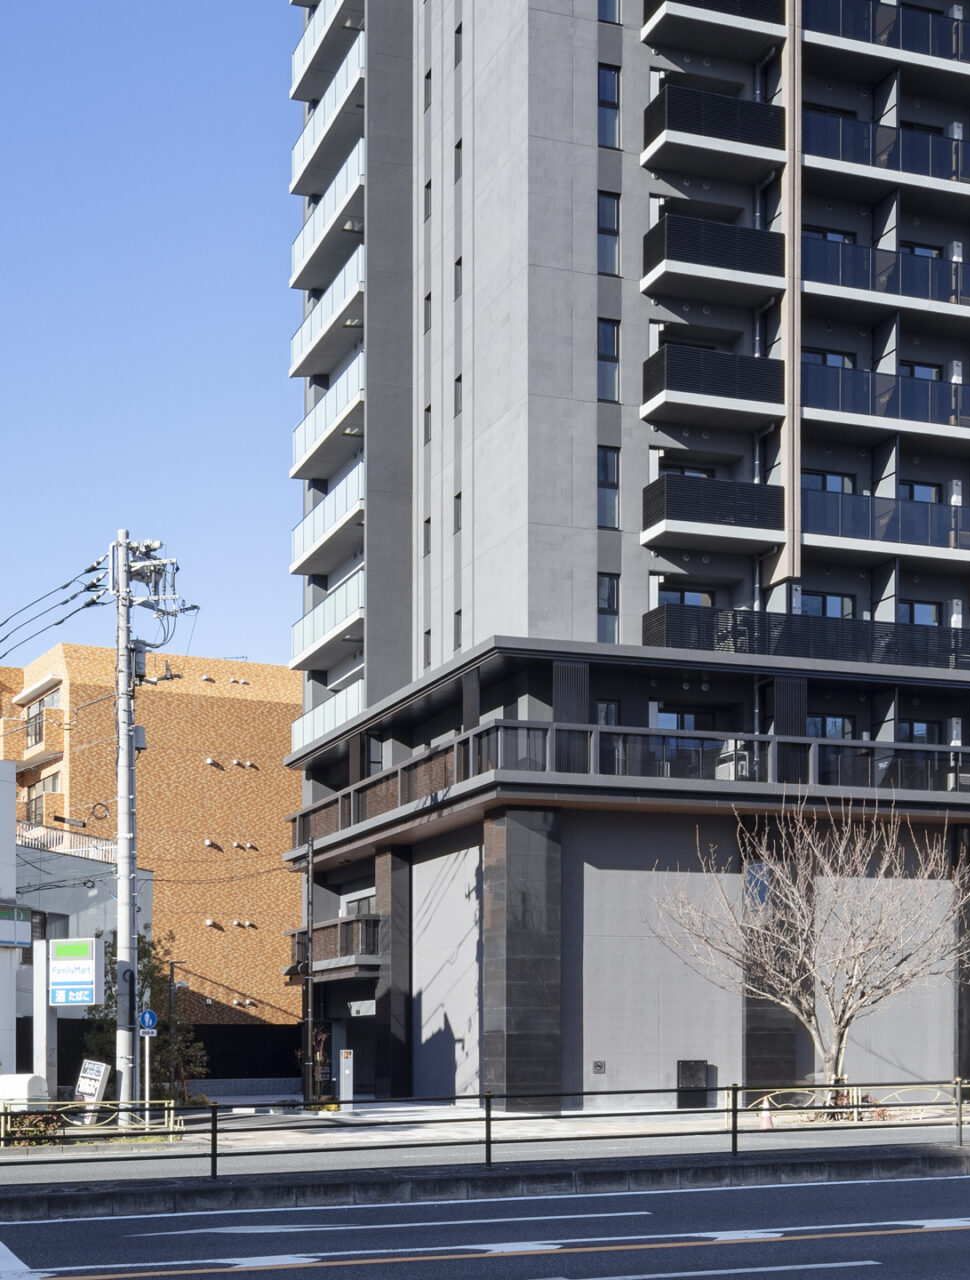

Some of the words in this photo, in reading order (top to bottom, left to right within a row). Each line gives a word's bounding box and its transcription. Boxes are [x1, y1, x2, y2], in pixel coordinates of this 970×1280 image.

[52, 965, 91, 977] FamilyMart
[68, 990, 90, 1001] たばこ
